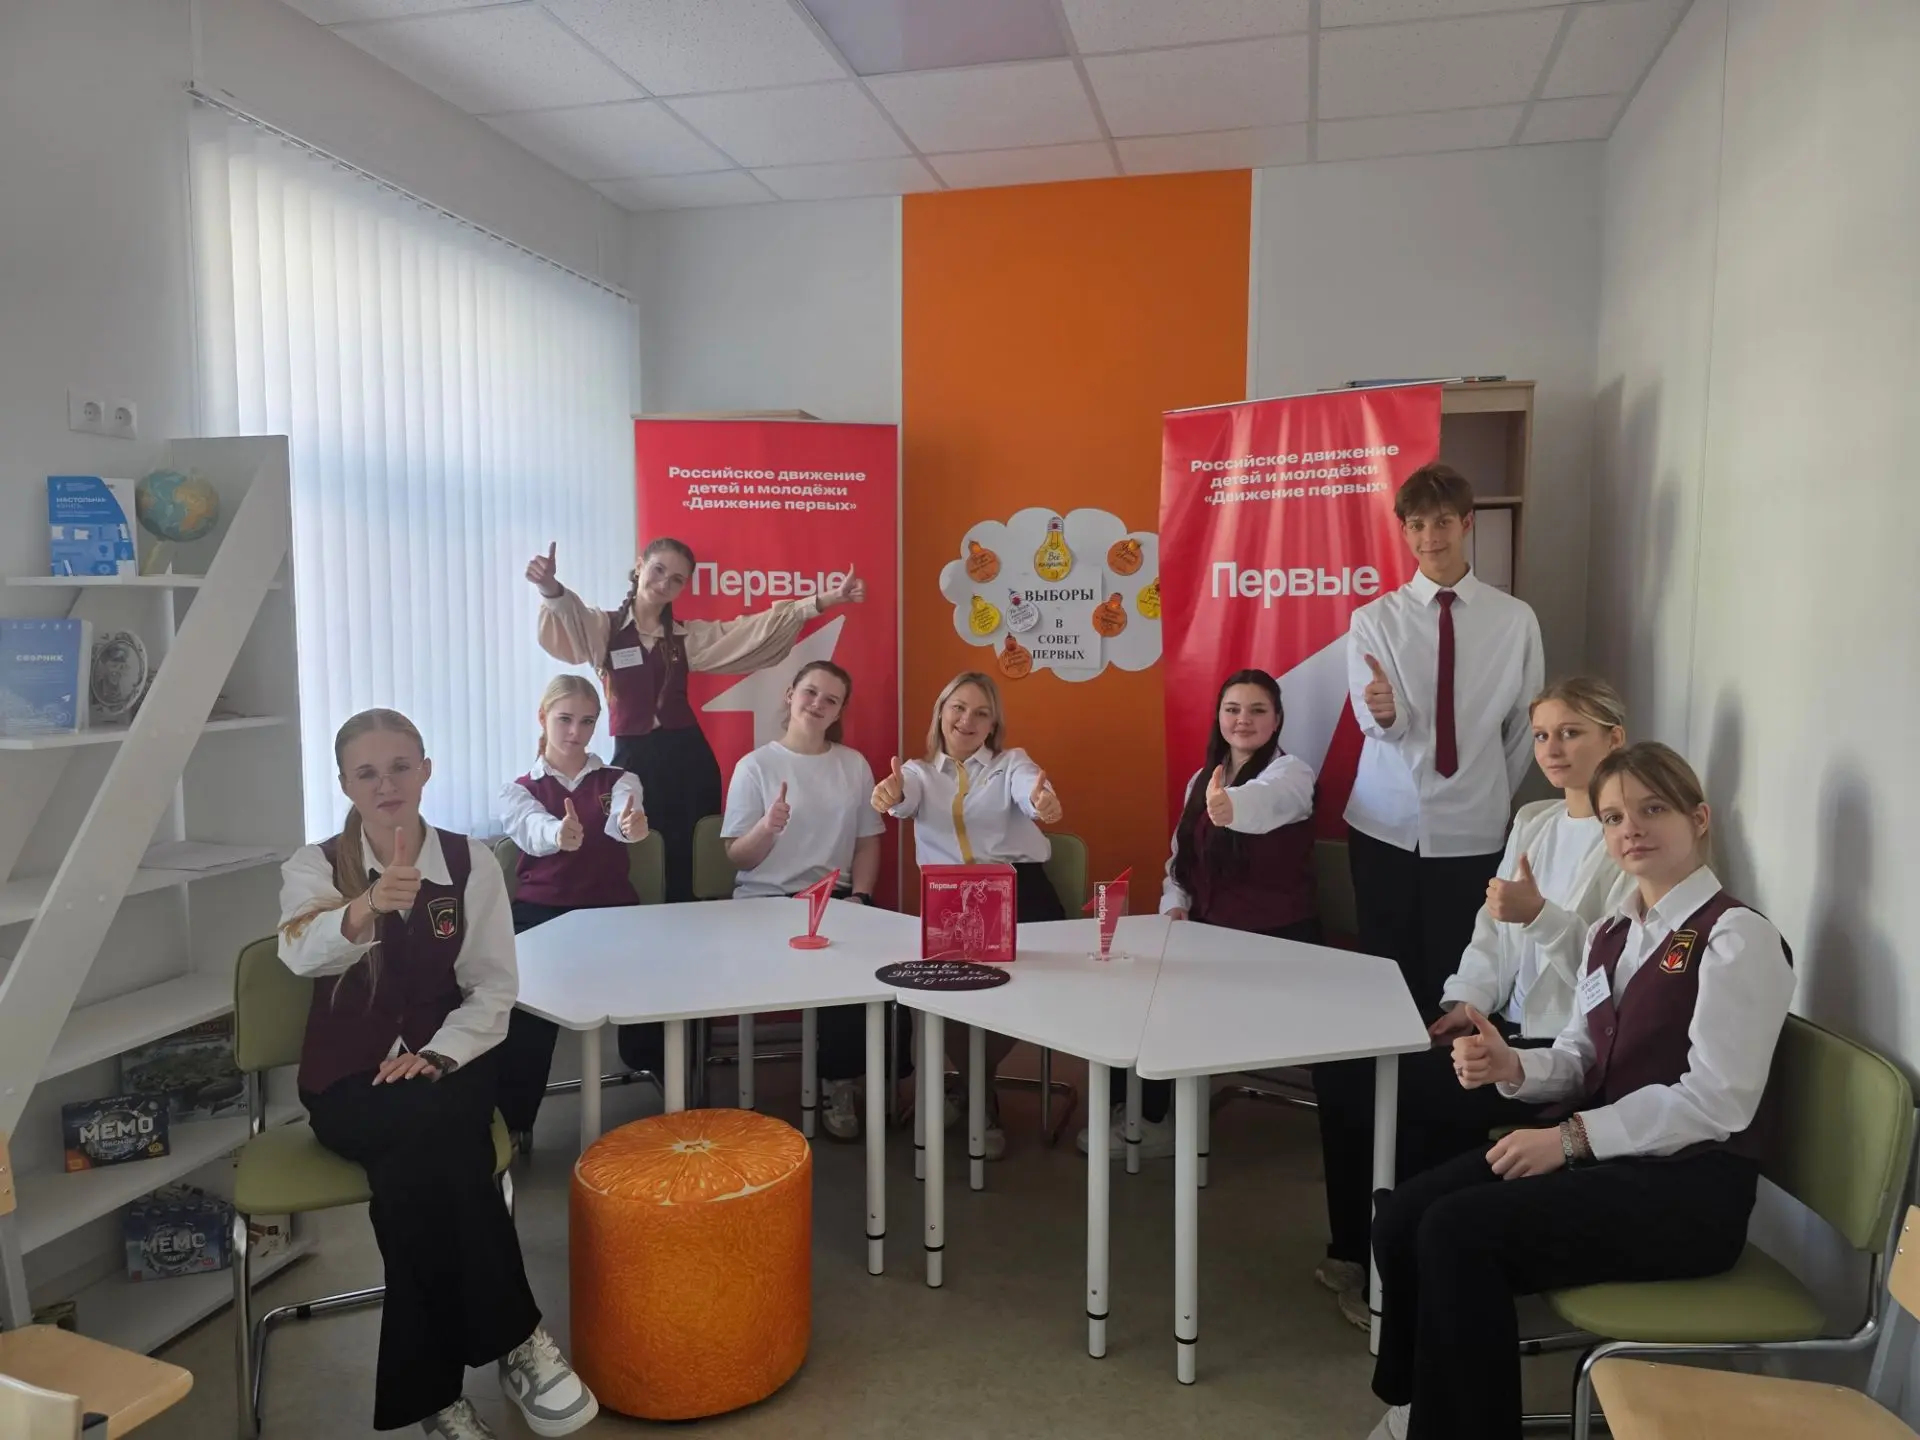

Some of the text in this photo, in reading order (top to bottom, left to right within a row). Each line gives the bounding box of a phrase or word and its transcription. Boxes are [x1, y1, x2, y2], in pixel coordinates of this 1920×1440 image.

[1191, 445, 1399, 473] Российское движение
[668, 466, 866, 482] Российское движение
[1210, 463, 1379, 489] детей и молодёжи
[688, 482, 848, 497] детей и молодёжи
[1204, 481, 1388, 506] «Движение первых»
[682, 496, 857, 512] «Движение первых»
[1212, 561, 1380, 608] Первые
[1025, 588, 1094, 601] ВЫБОРЫ
[1055, 618, 1063, 628] В
[1037, 634, 1080, 645] СОВЕТ
[1032, 650, 1085, 660] ПЕРВЫХ
[929, 882, 957, 890] Первые
[1097, 884, 1108, 925] Первые
